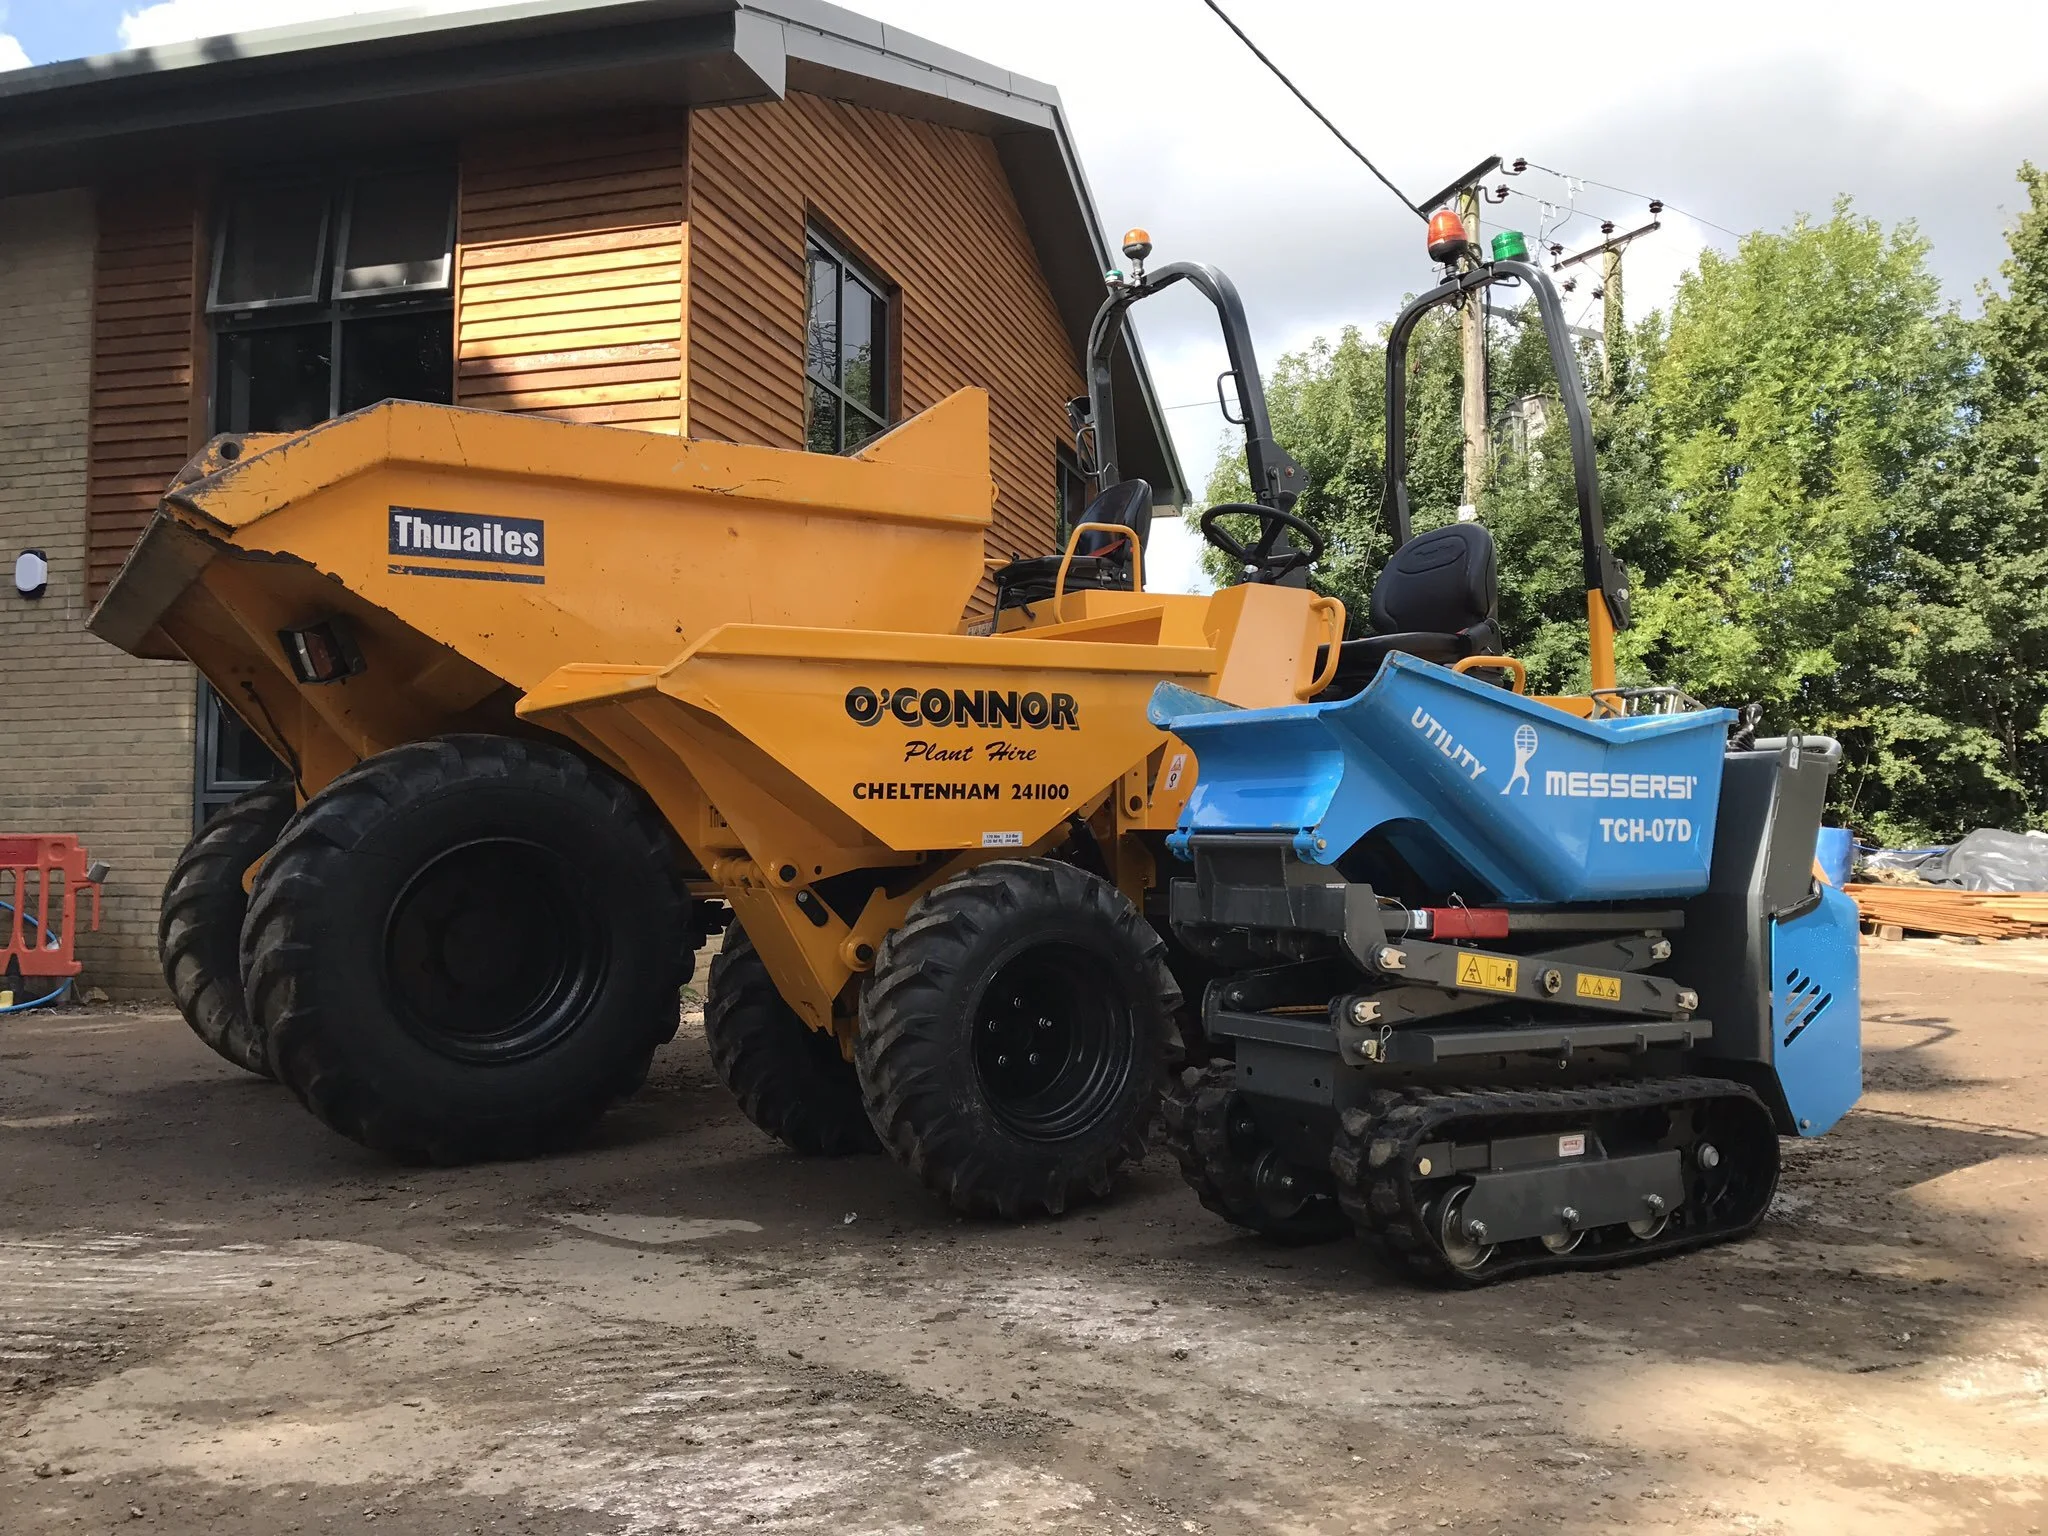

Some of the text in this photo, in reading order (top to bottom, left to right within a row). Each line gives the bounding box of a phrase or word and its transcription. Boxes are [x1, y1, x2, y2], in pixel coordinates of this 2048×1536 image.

[394, 514, 539, 557] Thwaites
[845, 686, 1080, 731] O'CONNOR
[904, 740, 1037, 762] Plant Hire
[1411, 706, 1487, 780] UTILITY
[853, 782, 1069, 800] CHELTENHAM 241100
[1600, 818, 1692, 843] TCH-07D
